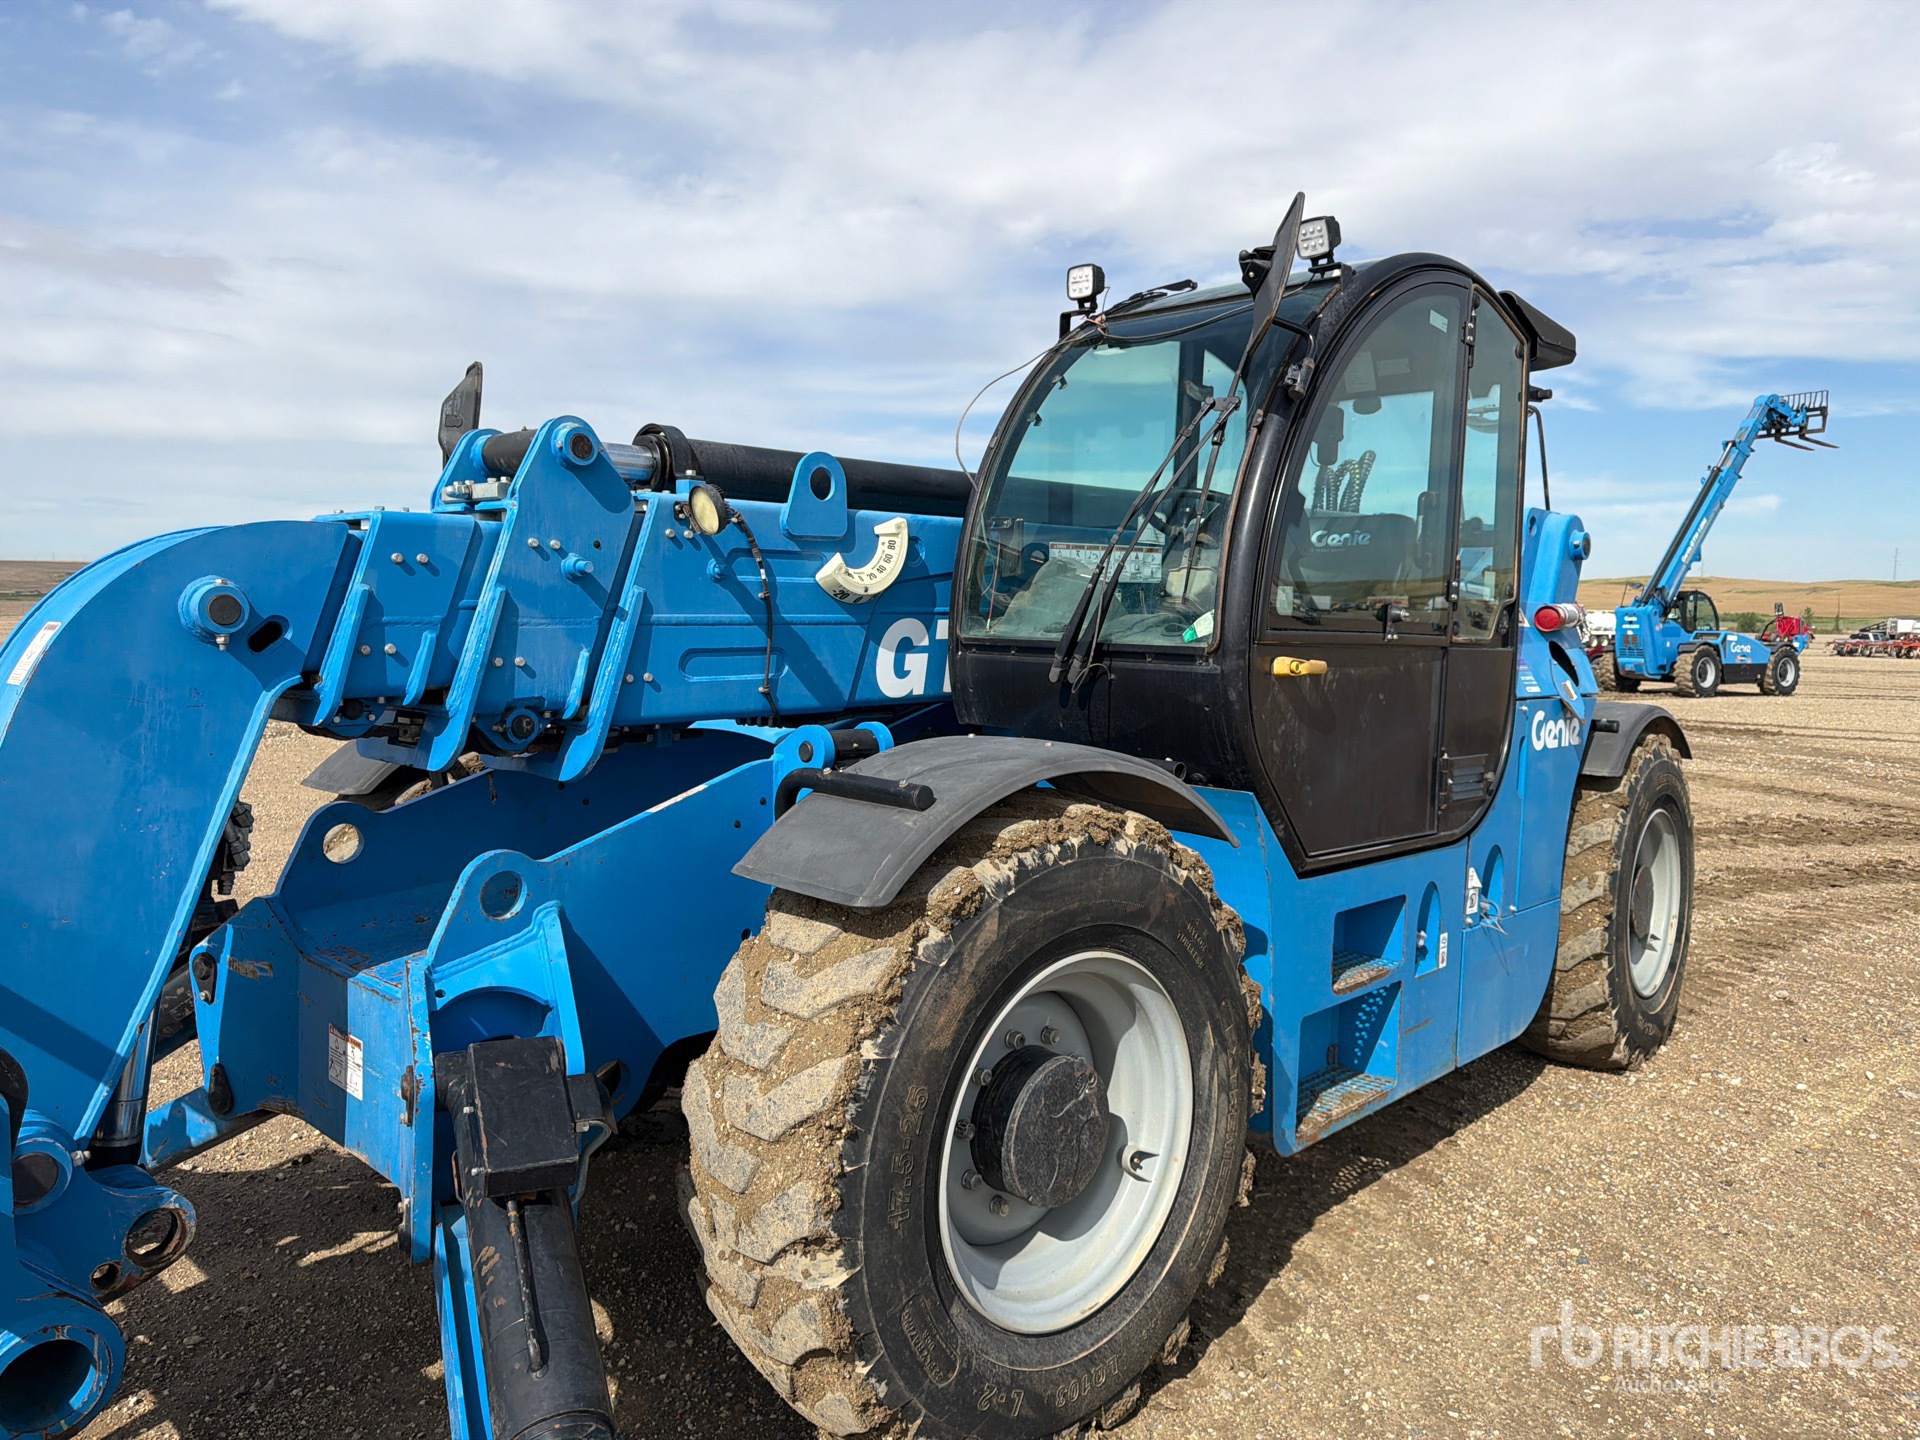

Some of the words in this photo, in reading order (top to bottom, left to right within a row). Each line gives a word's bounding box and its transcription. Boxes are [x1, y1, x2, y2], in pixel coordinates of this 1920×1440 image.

[1311, 529, 1371, 548] Genie
[887, 539, 897, 551] 80
[883, 553, 894, 564] 60
[876, 565, 887, 574] 40
[867, 572, 877, 581] 20
[832, 589, 850, 600] -20
[1731, 642, 1752, 653] Genie
[1531, 709, 1580, 751] Genie
[887, 1085, 929, 1230] 17.5-25
[1054, 1353, 1120, 1409] LQ103
